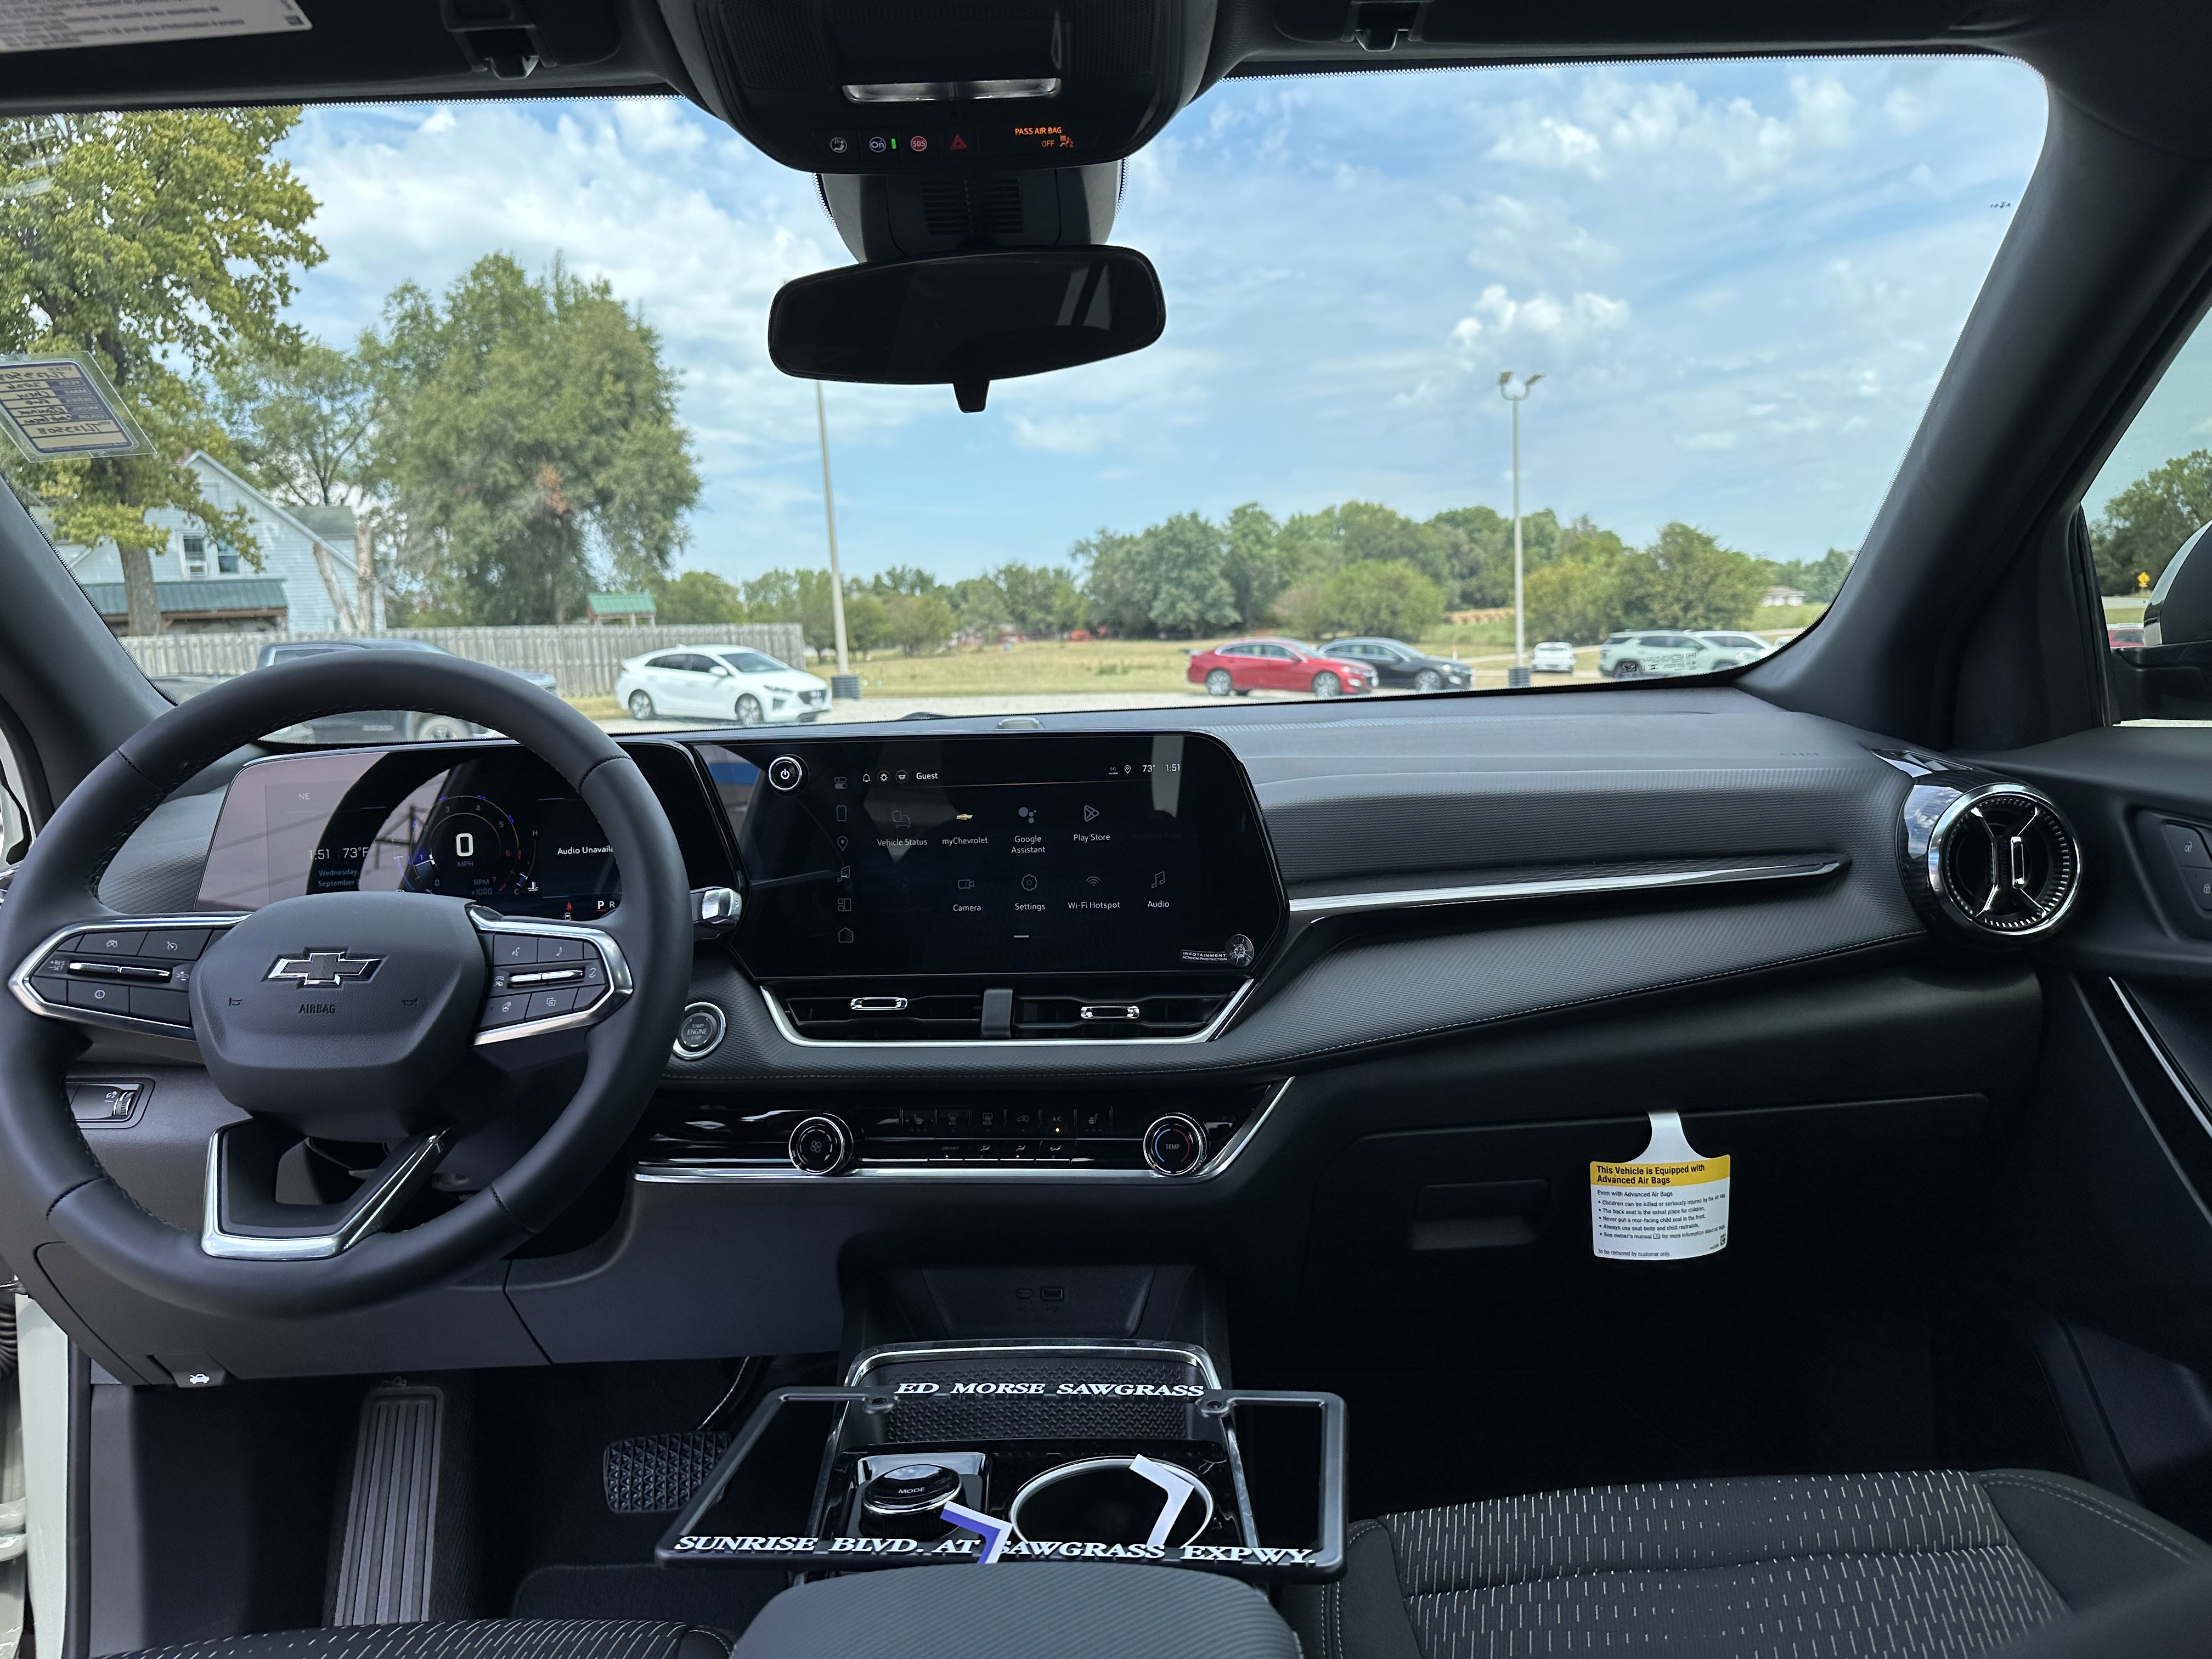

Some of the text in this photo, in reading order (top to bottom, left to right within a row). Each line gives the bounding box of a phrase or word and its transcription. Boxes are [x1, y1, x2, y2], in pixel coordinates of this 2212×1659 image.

[1142, 764, 1155, 772] 73°
[942, 836, 988, 846] myChevrolet
[1014, 835, 1042, 844] Google
[1074, 834, 1088, 843] Play
[455, 833, 473, 857] 0
[309, 849, 330, 861] 1:51
[342, 847, 369, 859] 73°F
[557, 847, 580, 855] Audio
[318, 880, 354, 888] September
[597, 900, 616, 910] P R
[1014, 902, 1046, 912] Settings
[1090, 901, 1121, 910] Hotspot
[298, 1003, 336, 1014] AIRBAG
[1596, 1165, 1613, 1174] This
[1615, 1166, 1644, 1175] Vehicle
[1655, 1165, 1689, 1176] Equipped
[1691, 1164, 1705, 1172] with
[1597, 1175, 1635, 1184] Advanced
[1651, 1176, 1671, 1185] Bags
[894, 1382, 1205, 1397] ED MORSE SAWGRASS
[674, 1536, 819, 1551] SUNRISE
[828, 1537, 925, 1553] BLVD.
[932, 1539, 981, 1554] AT
[1180, 1545, 1317, 1565] EXPWY.
